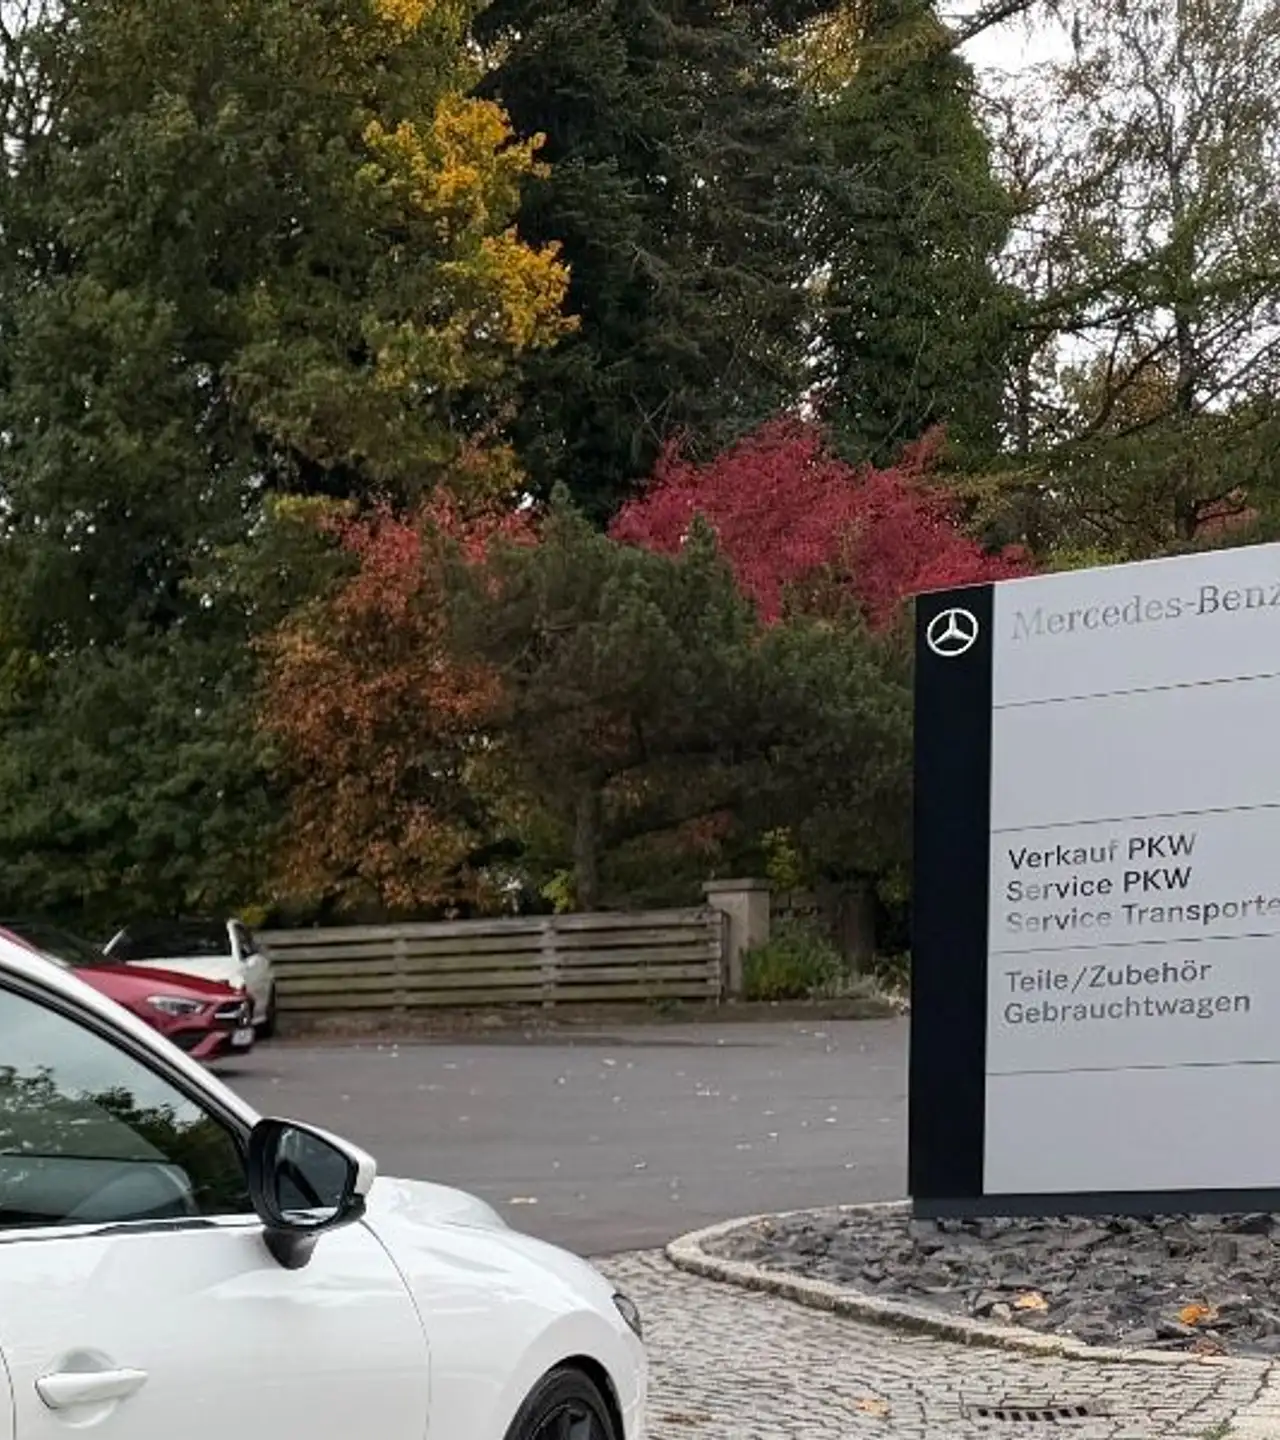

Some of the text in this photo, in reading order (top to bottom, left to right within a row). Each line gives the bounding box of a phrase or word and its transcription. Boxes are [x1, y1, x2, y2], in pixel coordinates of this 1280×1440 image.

[1011, 584, 1280, 640] Mercedes-Benz
[1008, 833, 1197, 870] Verkauf PKW
[1006, 866, 1193, 902] Service PKW
[1006, 906, 1113, 934] Service
[1005, 959, 1212, 994] Teile/Zubehör
[1003, 994, 1252, 1025] Gebrauchtwagen
